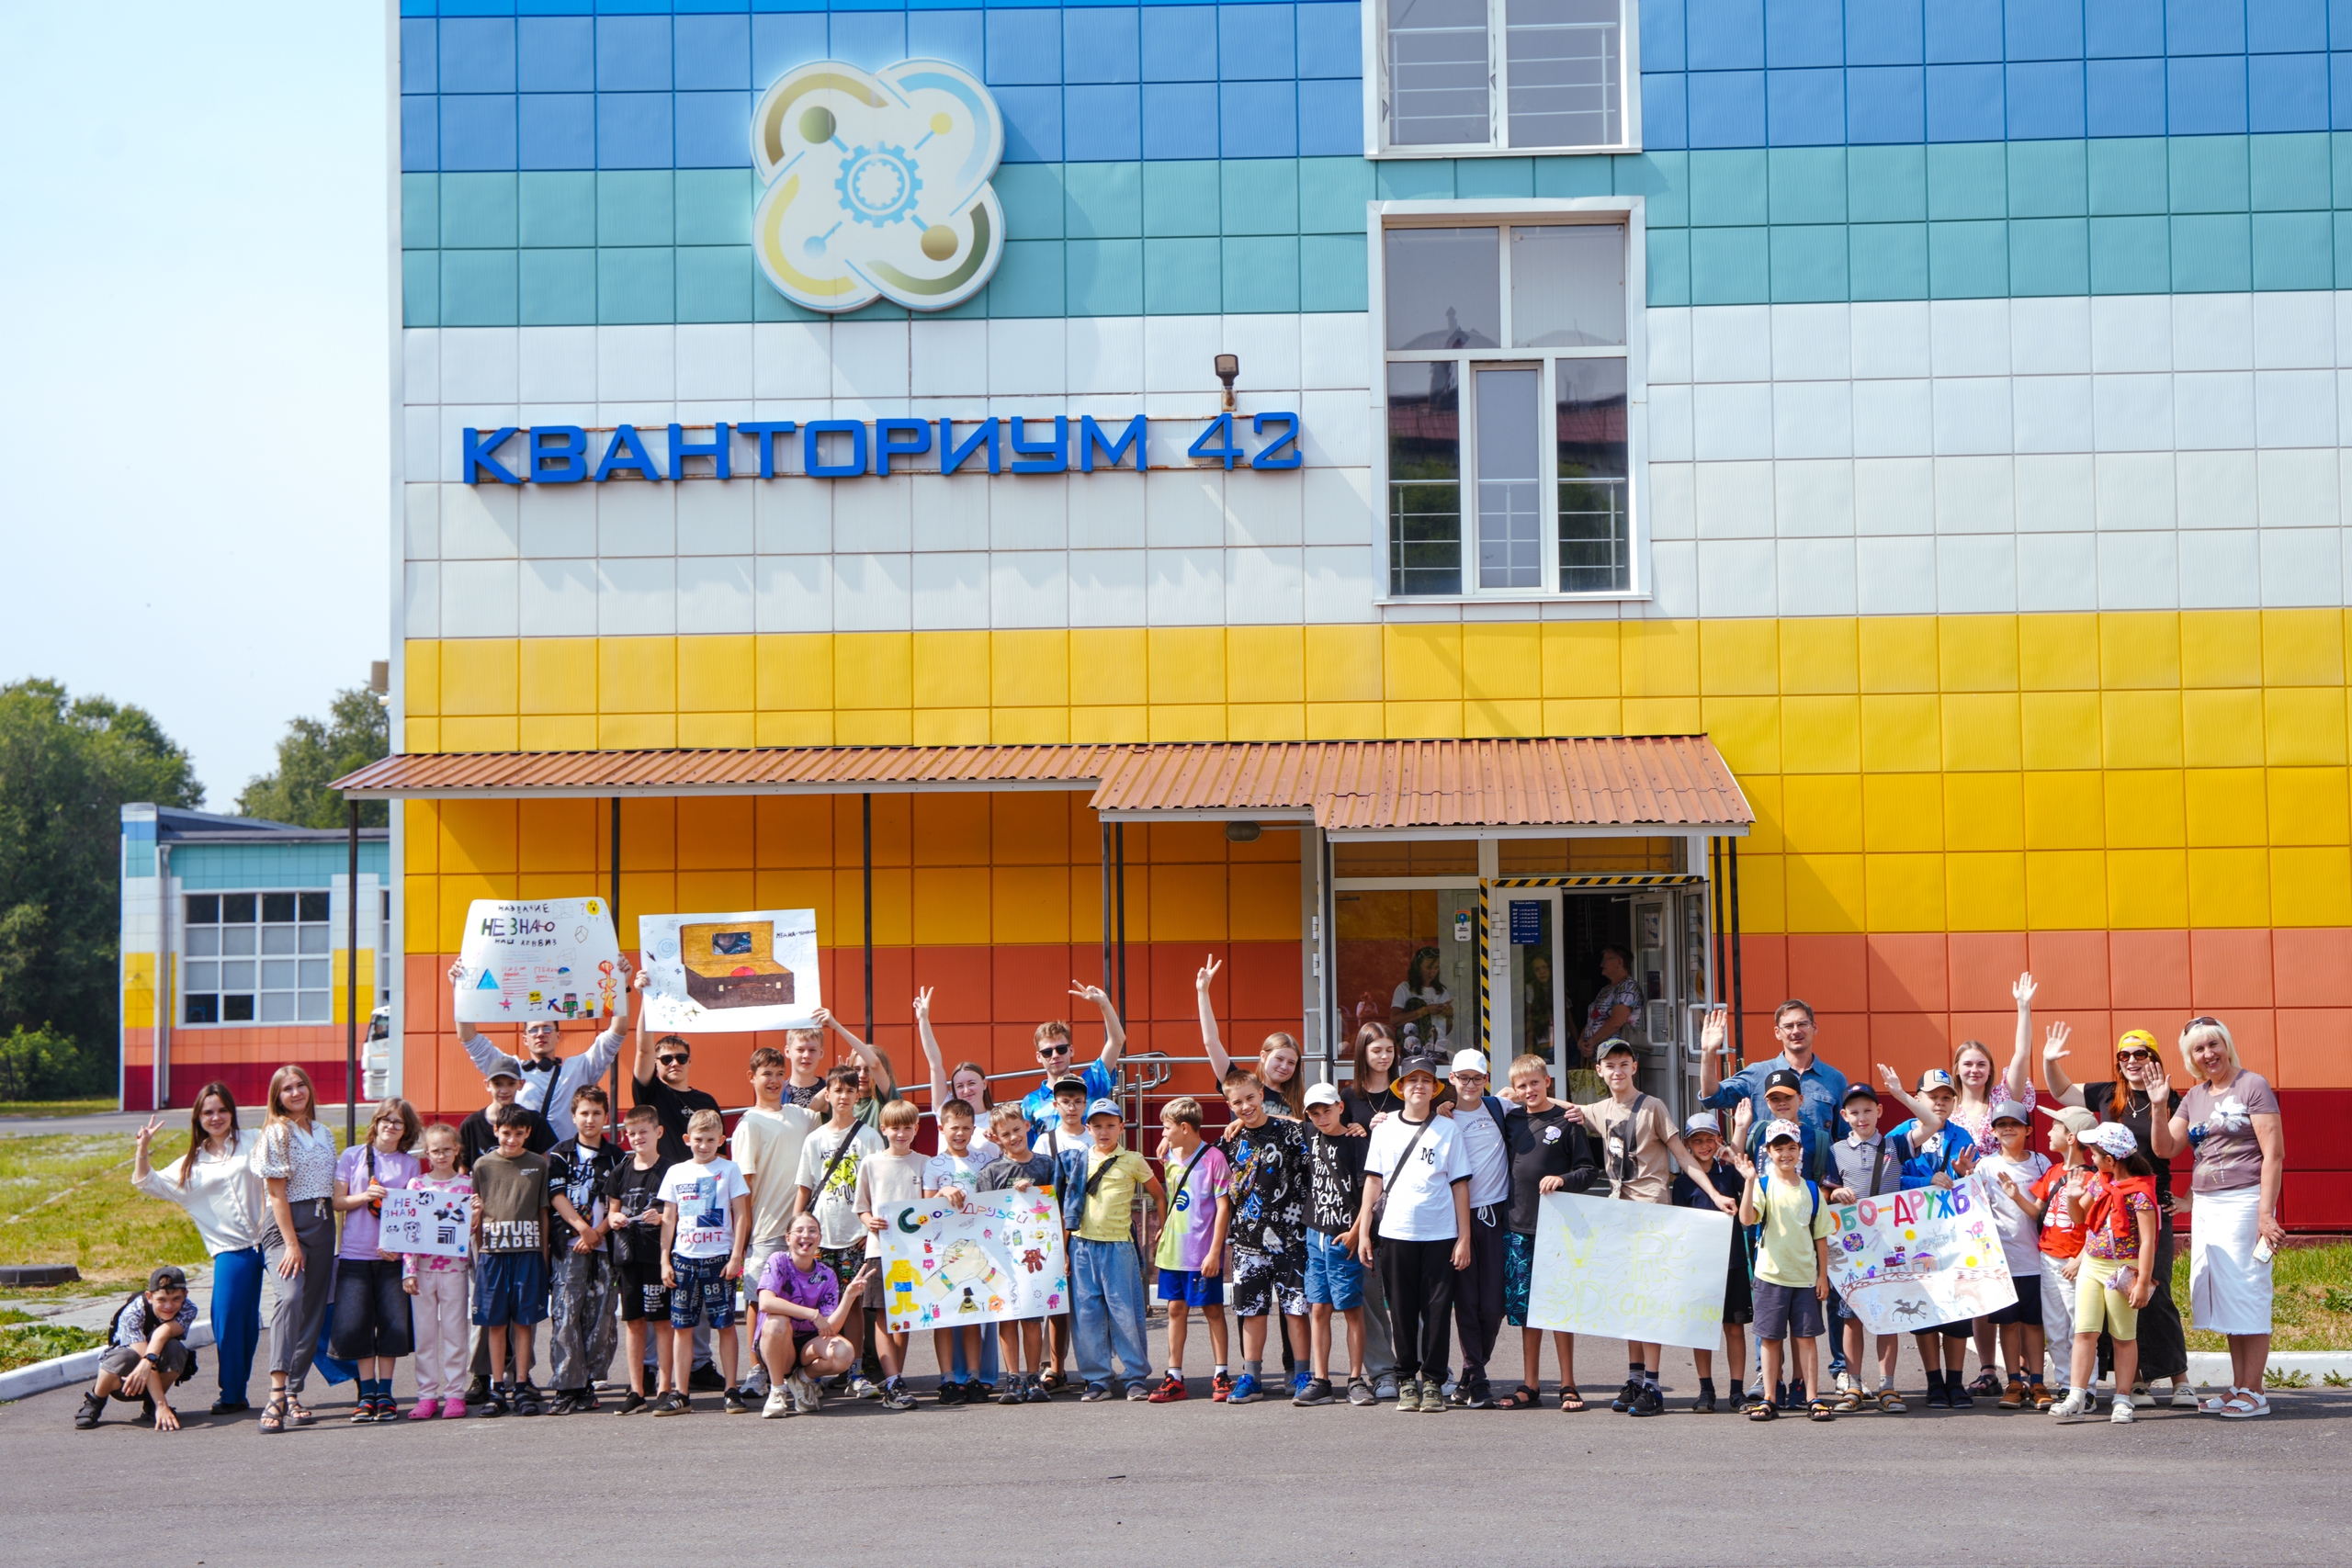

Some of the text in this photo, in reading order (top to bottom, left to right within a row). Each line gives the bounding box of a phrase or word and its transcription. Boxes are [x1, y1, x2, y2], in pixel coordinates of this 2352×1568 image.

[463, 412, 1302, 484] КВАНТОРИУМ 42
[481, 918, 555, 937] НЕ ЗНАЮ
[482, 1221, 540, 1237] FUTURE
[481, 1236, 540, 1249] LEADER
[674, 1289, 687, 1302] 68
[704, 1282, 720, 1295] 68
